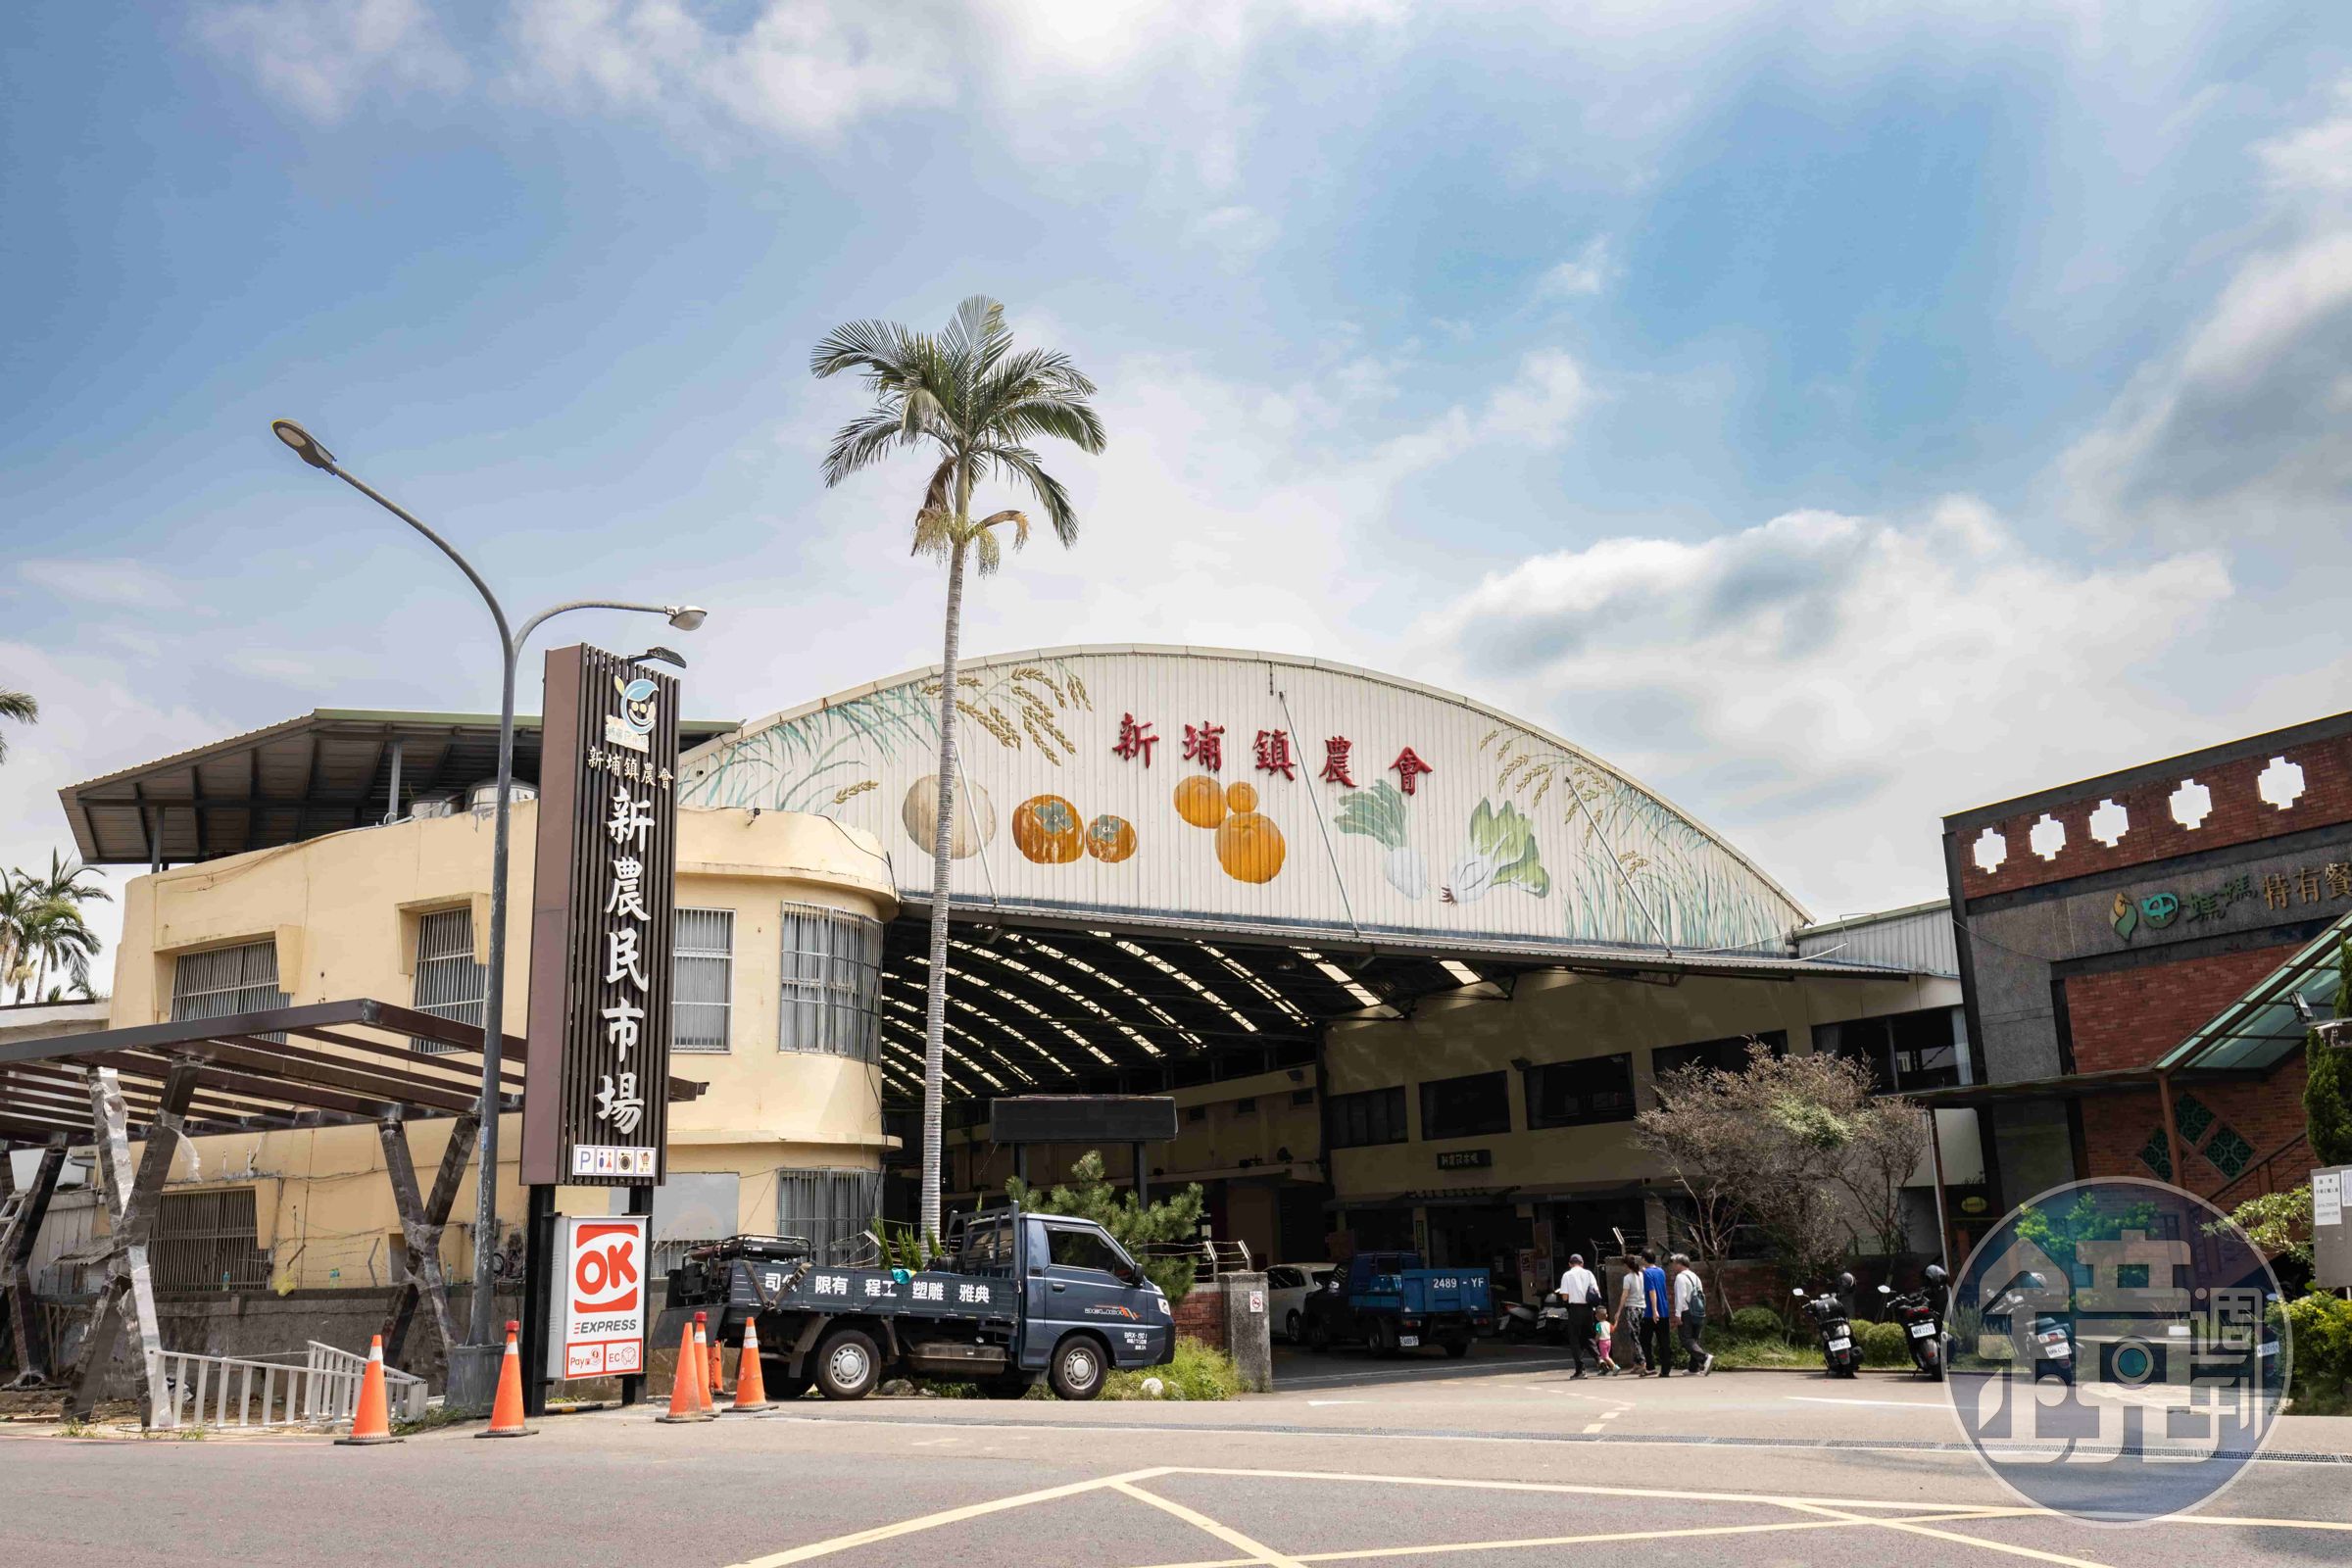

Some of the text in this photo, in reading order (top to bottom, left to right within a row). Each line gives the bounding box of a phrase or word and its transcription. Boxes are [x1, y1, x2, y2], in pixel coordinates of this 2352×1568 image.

[588, 746, 673, 791] 新埔鎮農會
[1112, 711, 1433, 796] 新埔鎮農會
[595, 785, 655, 1135] 新農民市場
[576, 1241, 637, 1295] OK
[1433, 1278, 1457, 1289] 2489
[1471, 1277, 1485, 1288] YF
[578, 1319, 637, 1334] EXPRESS
[570, 1356, 584, 1369] Pay
[609, 1352, 620, 1363] EC
